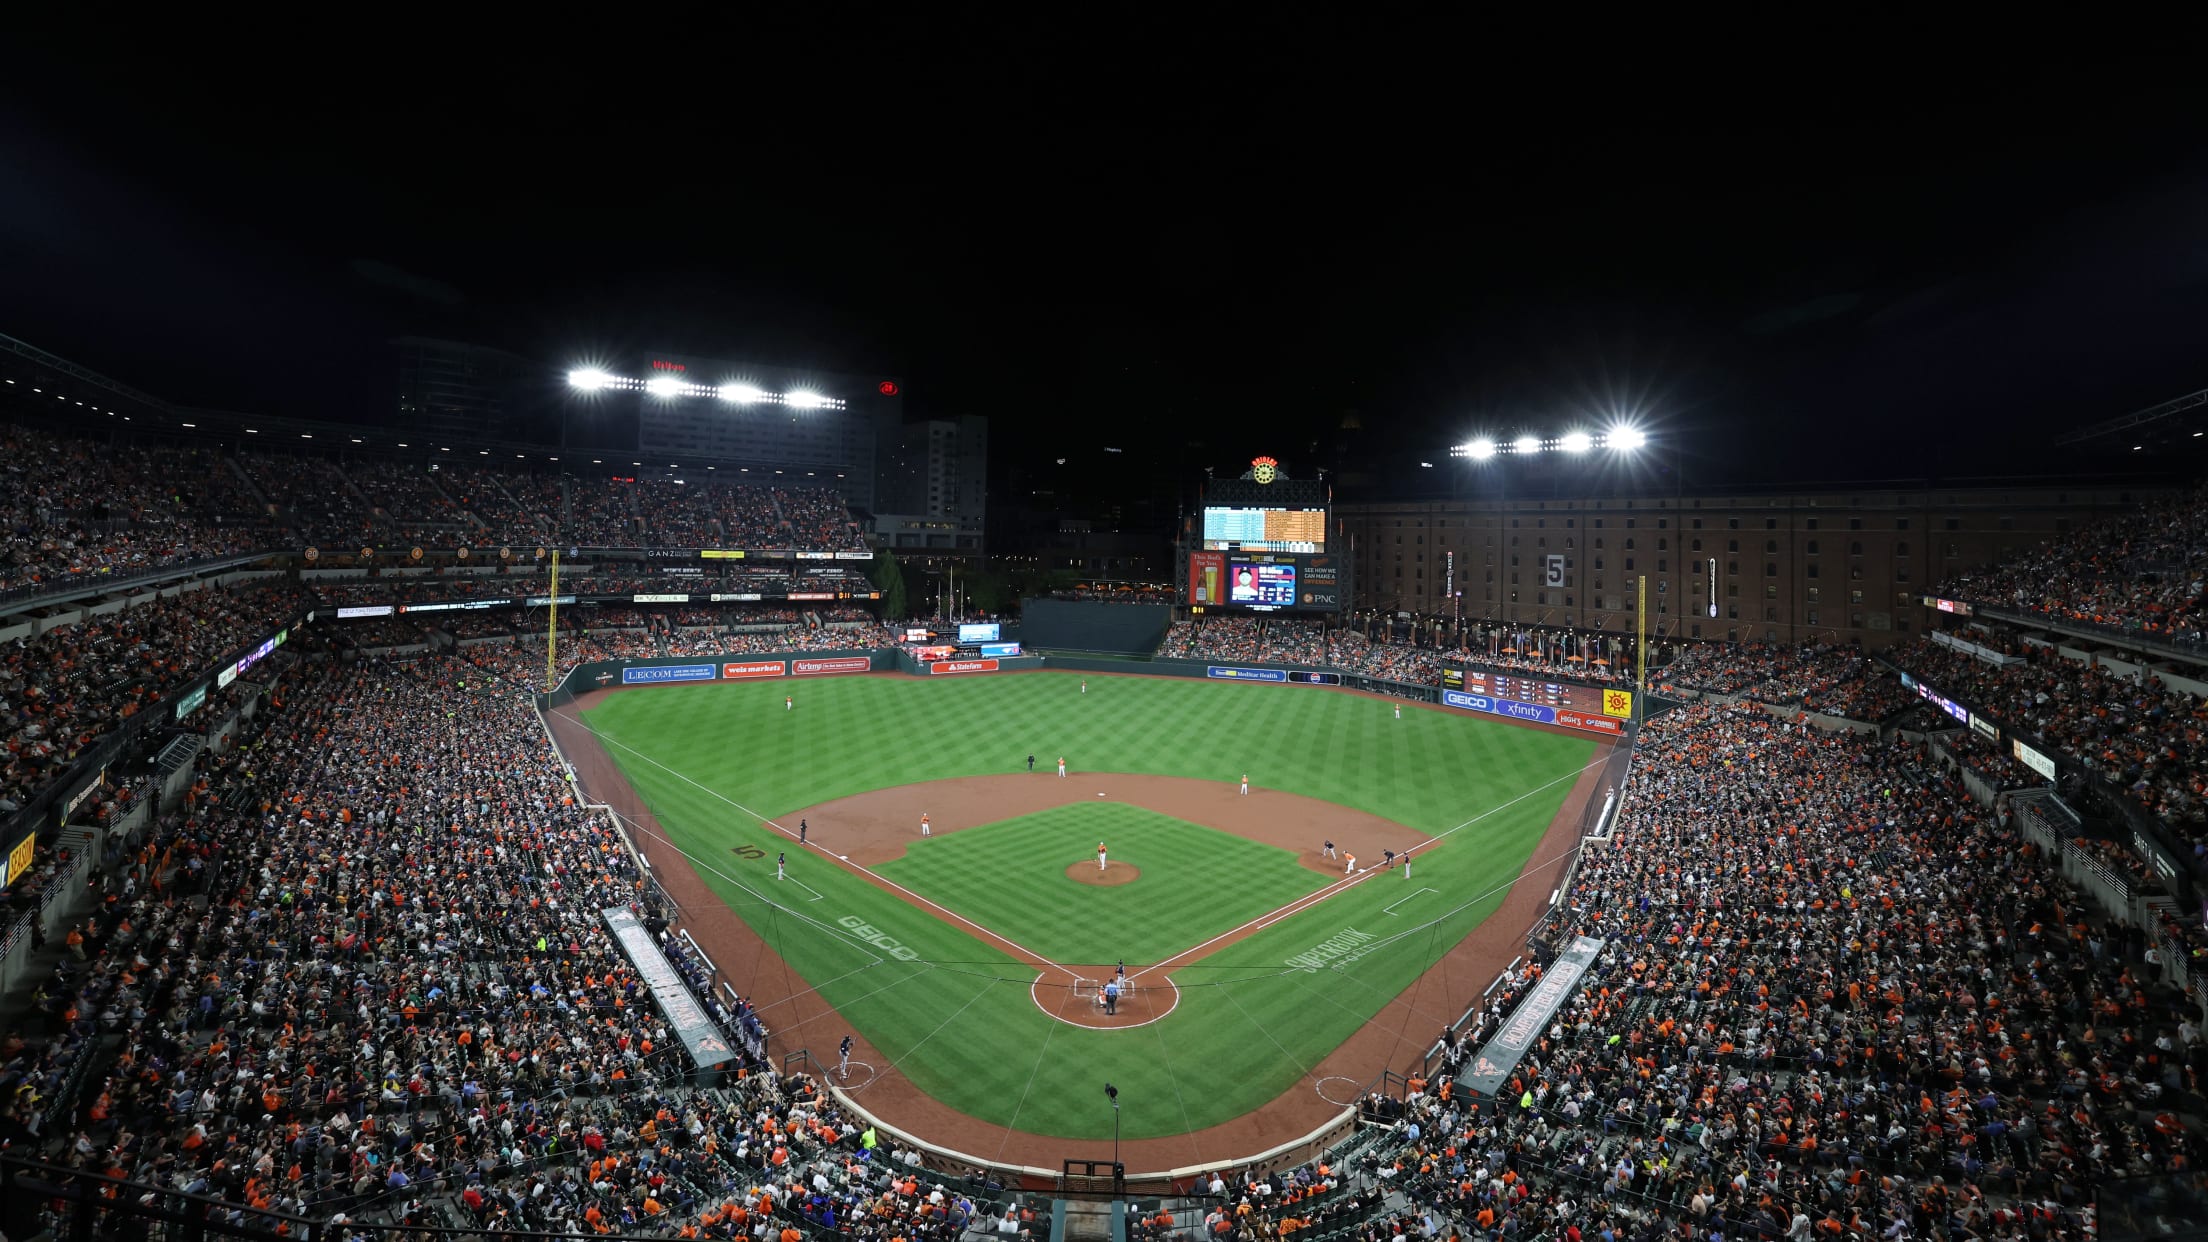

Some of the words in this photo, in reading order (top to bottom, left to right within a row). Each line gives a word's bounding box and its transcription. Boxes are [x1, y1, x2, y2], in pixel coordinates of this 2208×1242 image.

[652, 360, 685, 372] Hilton
[648, 550, 675, 558] GANZ
[1548, 558, 1562, 583] 5
[1314, 595, 1336, 604] PNC
[628, 669, 672, 680] LECOM
[747, 664, 781, 673] markets
[1448, 693, 1487, 708] GEICO
[1508, 703, 1542, 719] xfinity
[837, 915, 919, 961] GEICO
[1284, 926, 1378, 974] SUPERBOOK
